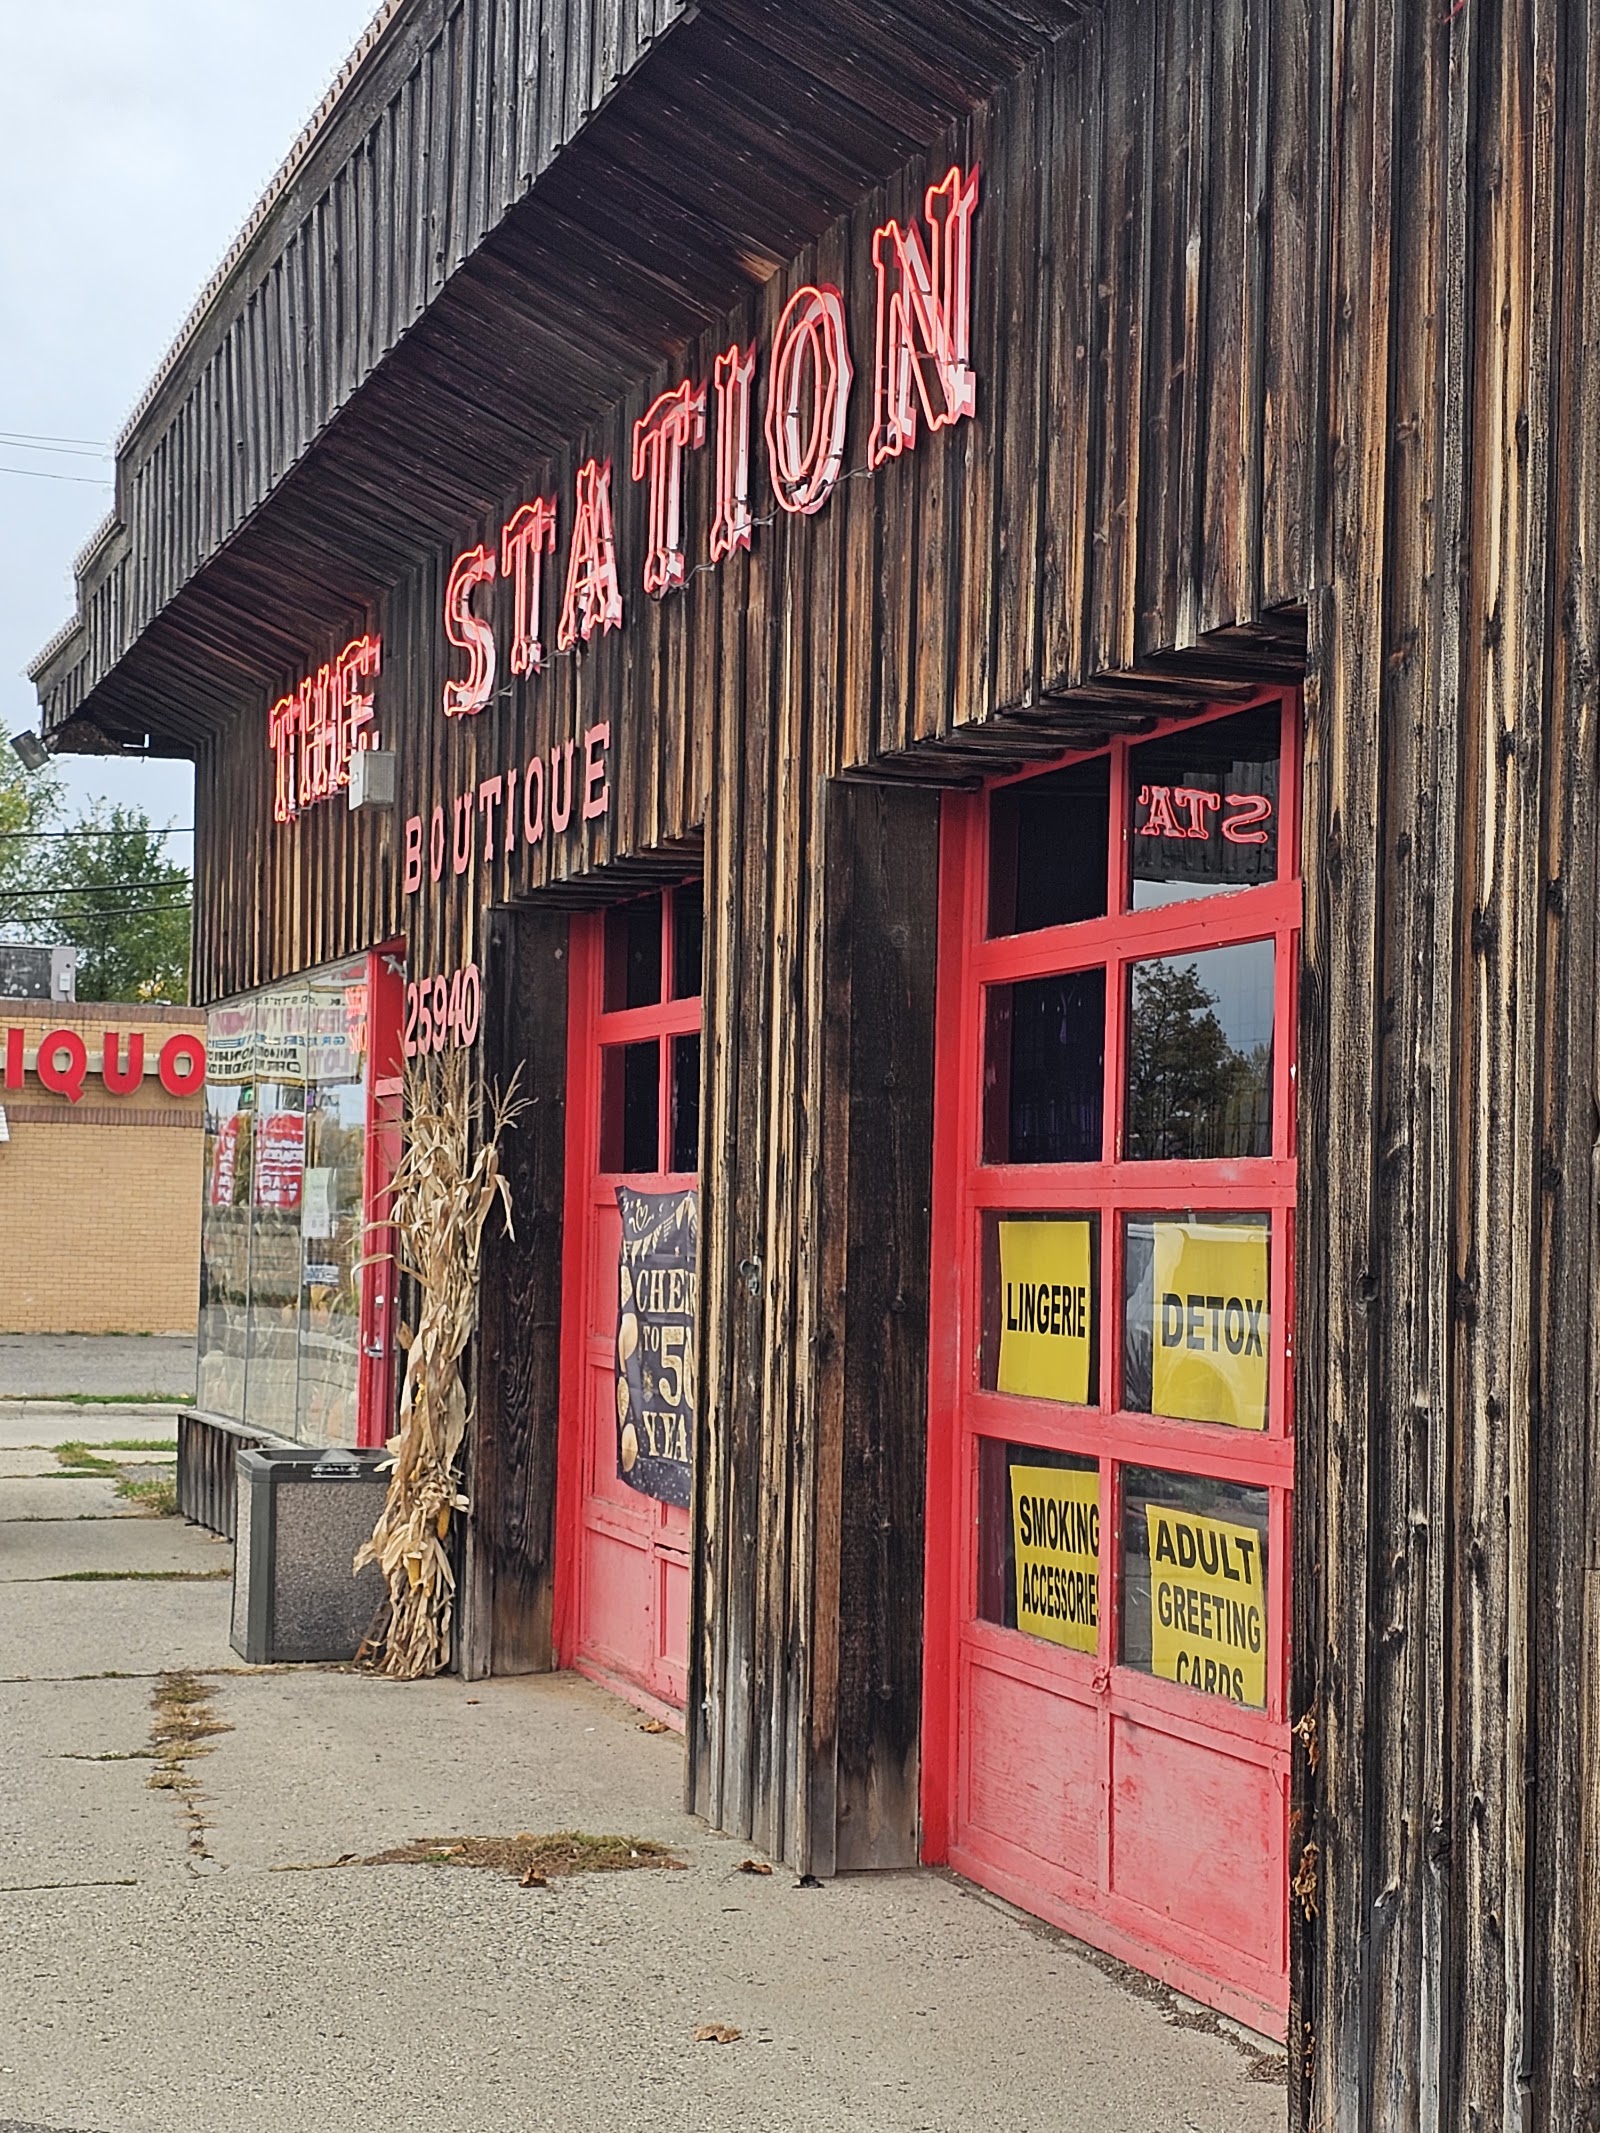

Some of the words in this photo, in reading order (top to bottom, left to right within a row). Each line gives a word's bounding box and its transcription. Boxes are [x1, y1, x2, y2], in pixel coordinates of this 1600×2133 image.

[269, 634, 381, 823] THE
[443, 161, 979, 718] STATION
[405, 720, 610, 894] BOUTIQUE
[404, 963, 479, 1057] 25940
[643, 1326, 659, 1352] TO
[1006, 1282, 1086, 1338] LINGERIE
[1162, 1292, 1263, 1357] DETOX
[642, 1411, 693, 1463] YEA
[1019, 1495, 1099, 1557] SMOKING
[1155, 1519, 1254, 1586] ADULT
[1022, 1562, 1099, 1627] ACCESSORIE
[1157, 1581, 1261, 1653] GREETING
[1176, 1651, 1244, 1702] CARDS
